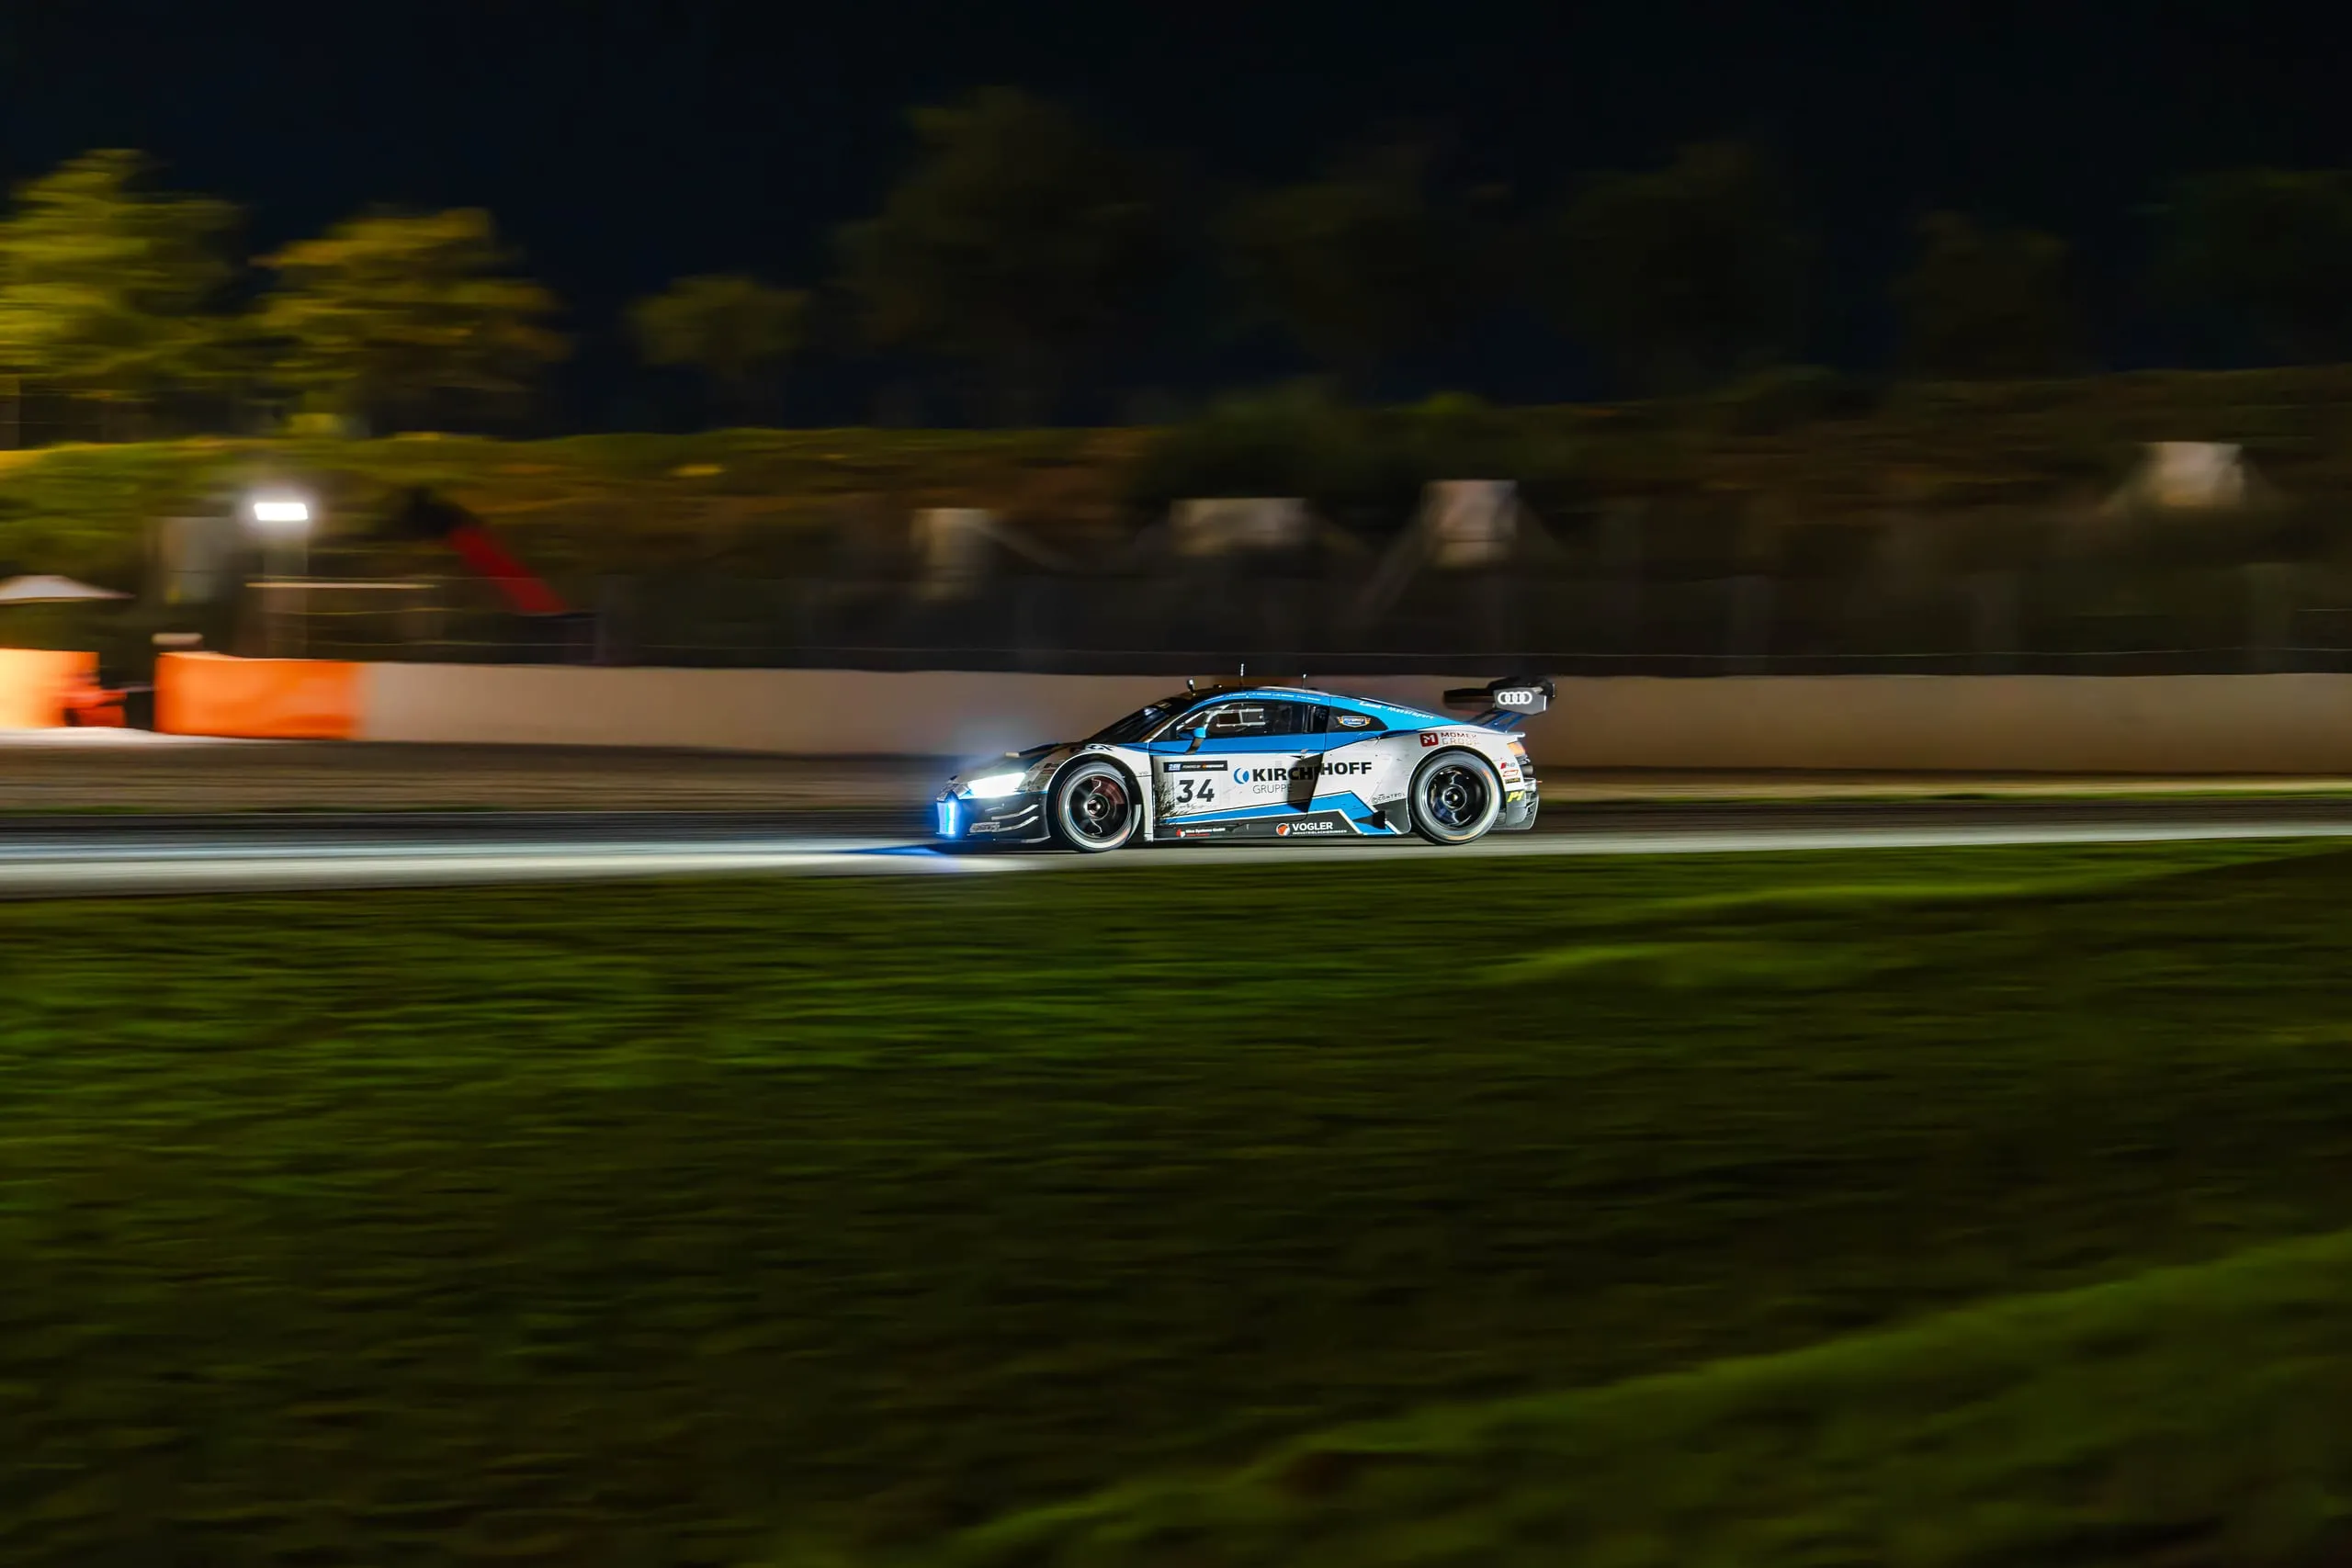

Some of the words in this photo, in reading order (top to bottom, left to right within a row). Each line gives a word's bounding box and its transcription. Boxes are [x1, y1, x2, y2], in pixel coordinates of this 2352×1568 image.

[1252, 761, 1372, 782] KIRCHHOFF
[1176, 778, 1215, 803] 34
[1252, 784, 1295, 794] GRUPPE
[1292, 821, 1333, 831] VOGLER
